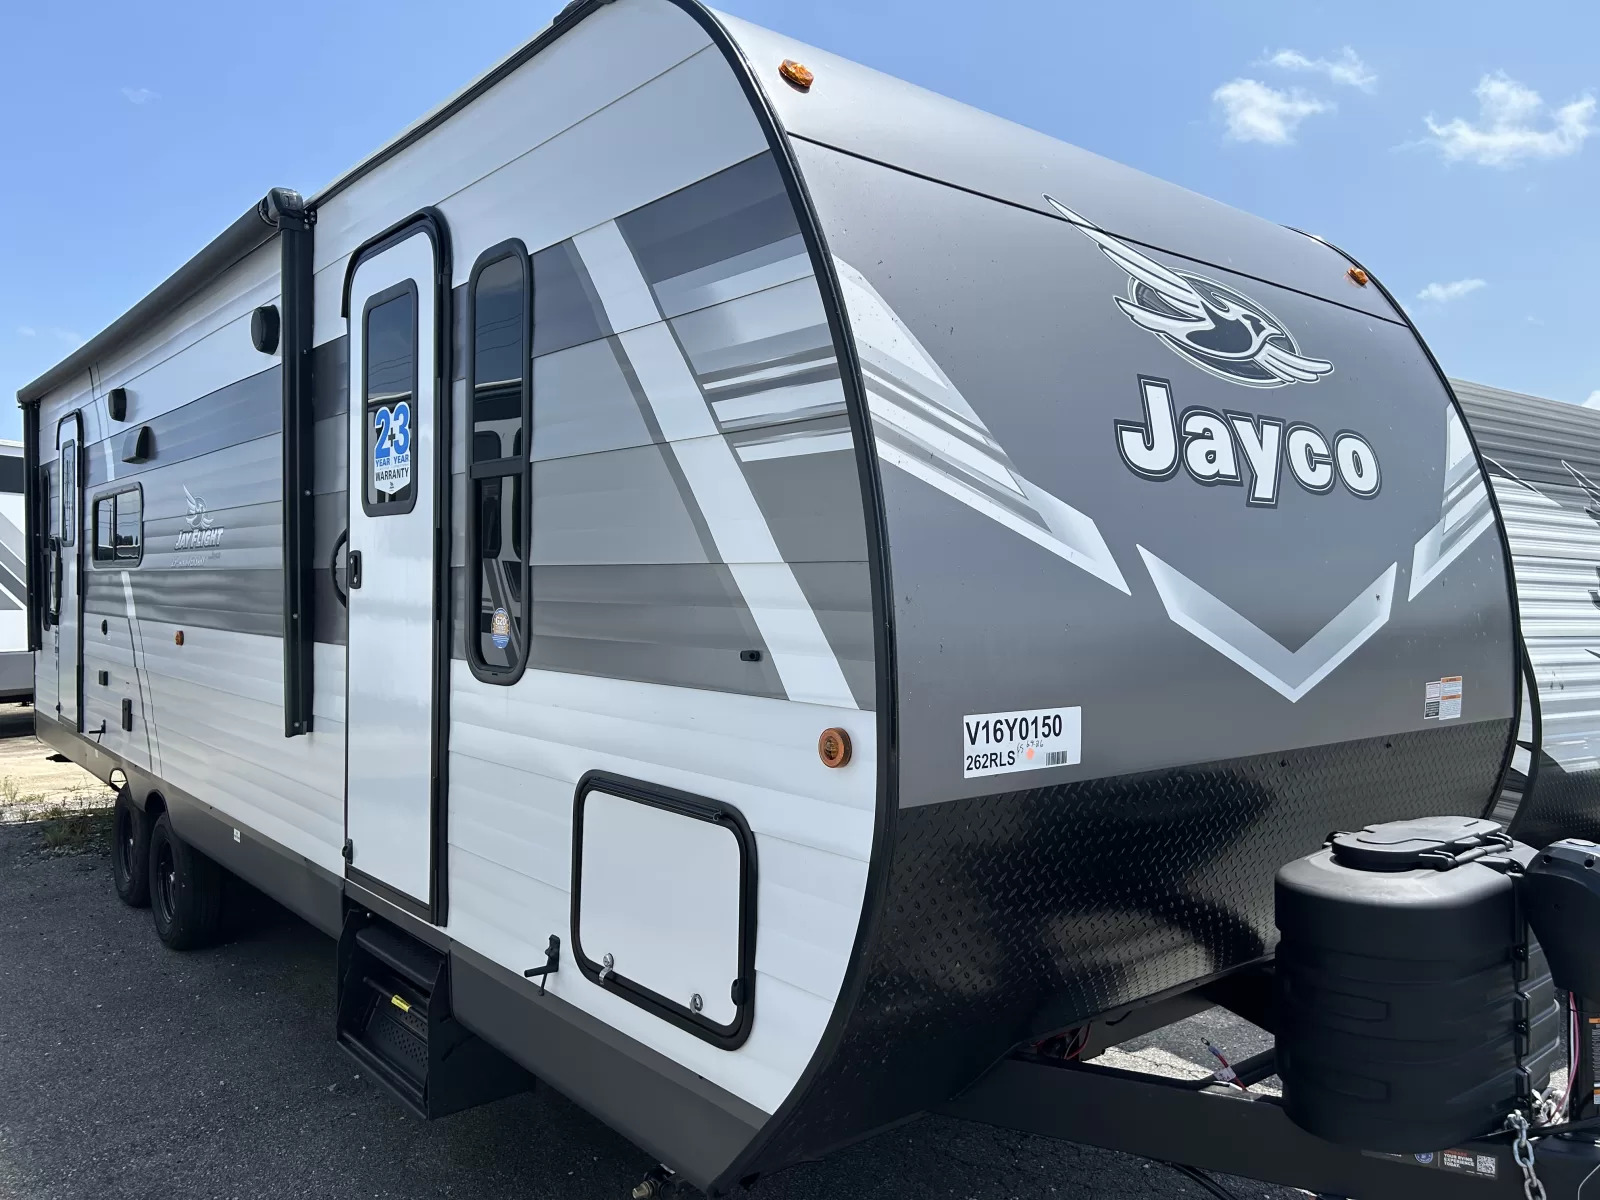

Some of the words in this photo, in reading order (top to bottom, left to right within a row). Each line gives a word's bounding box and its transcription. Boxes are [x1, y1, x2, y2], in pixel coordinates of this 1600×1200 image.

[1114, 374, 1382, 509] Jayco
[376, 457, 391, 467] YEAR
[393, 454, 409, 464] YEAR
[375, 467, 409, 482] WARRANTY
[174, 531, 192, 550] JAY
[191, 527, 224, 549] FLIGHT
[965, 714, 1062, 745] V16Y0150
[966, 750, 1015, 771] 262RLS
[1443, 1157, 1475, 1167] EXPERIENCE
